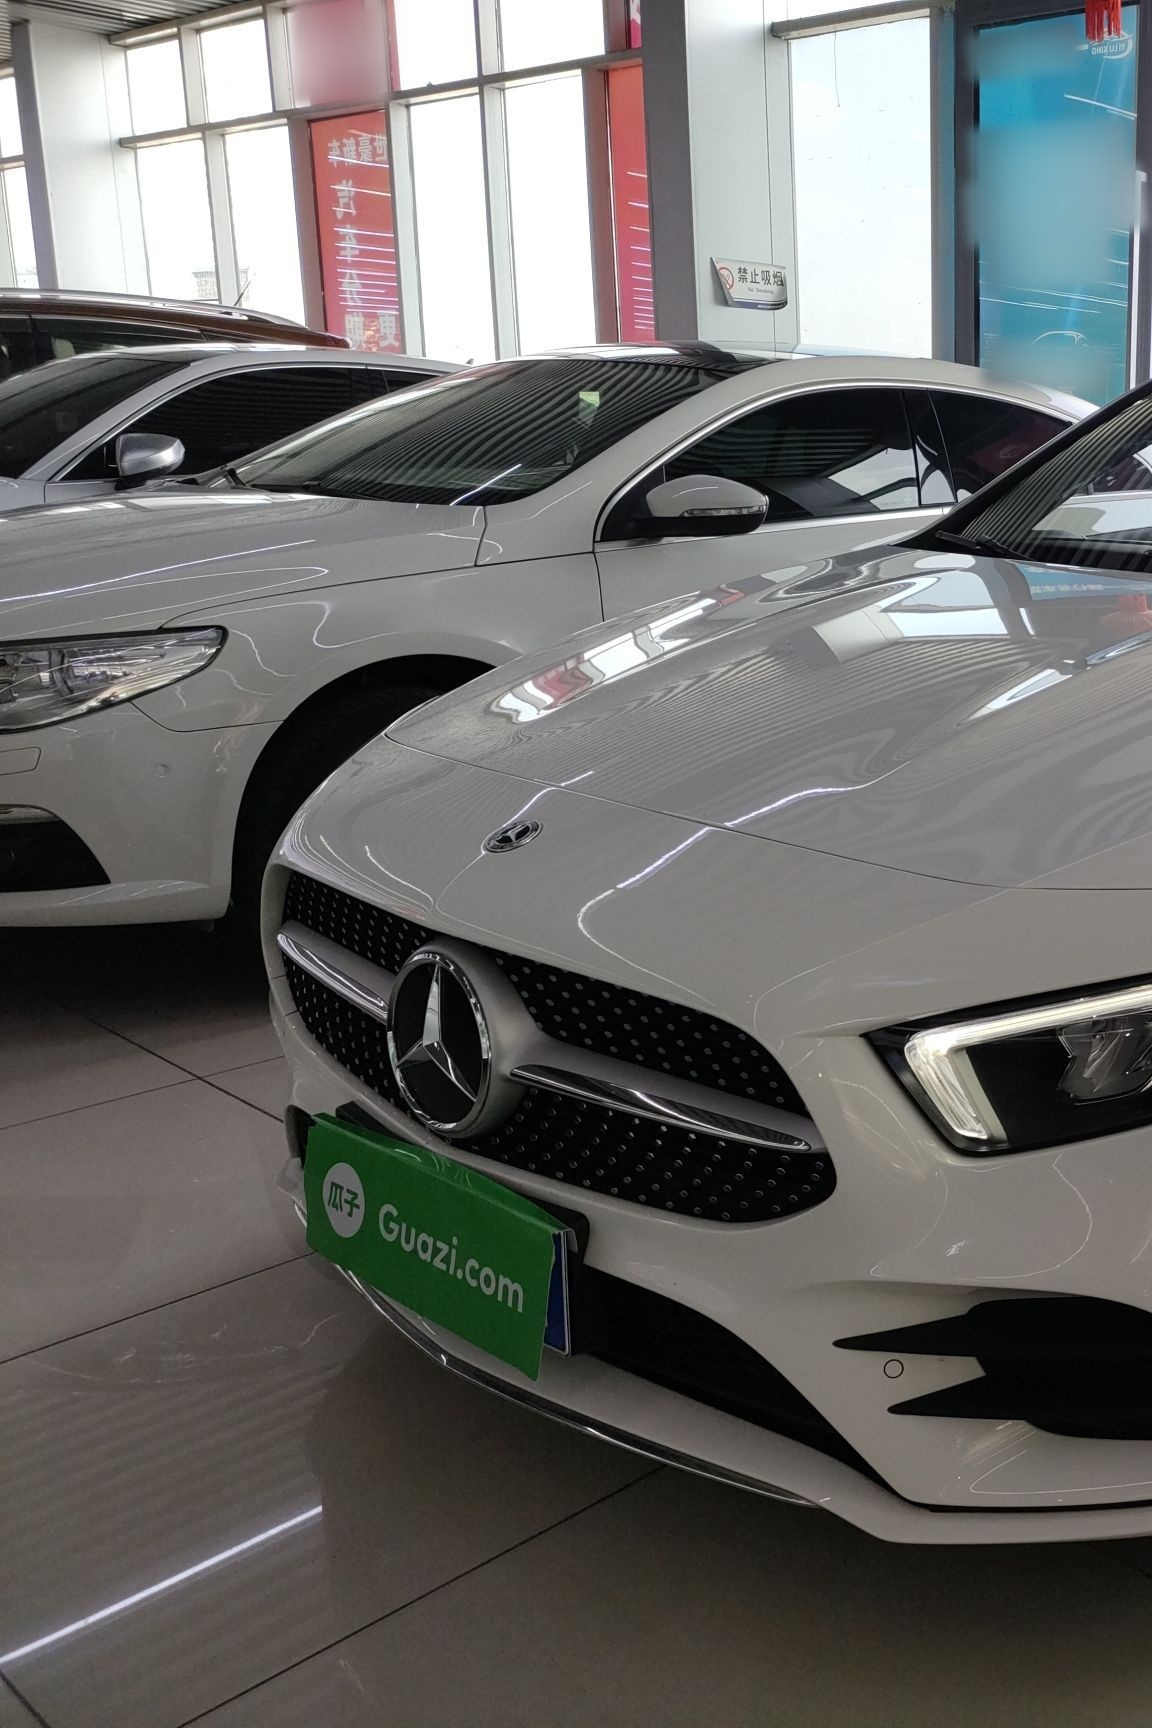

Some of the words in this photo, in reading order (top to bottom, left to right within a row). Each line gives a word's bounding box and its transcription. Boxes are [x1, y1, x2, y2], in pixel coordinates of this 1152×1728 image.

[737, 266, 784, 287] 禁止吸烟
[327, 1180, 360, 1218] 瓜子
[378, 1203, 524, 1314] Guazi.com
